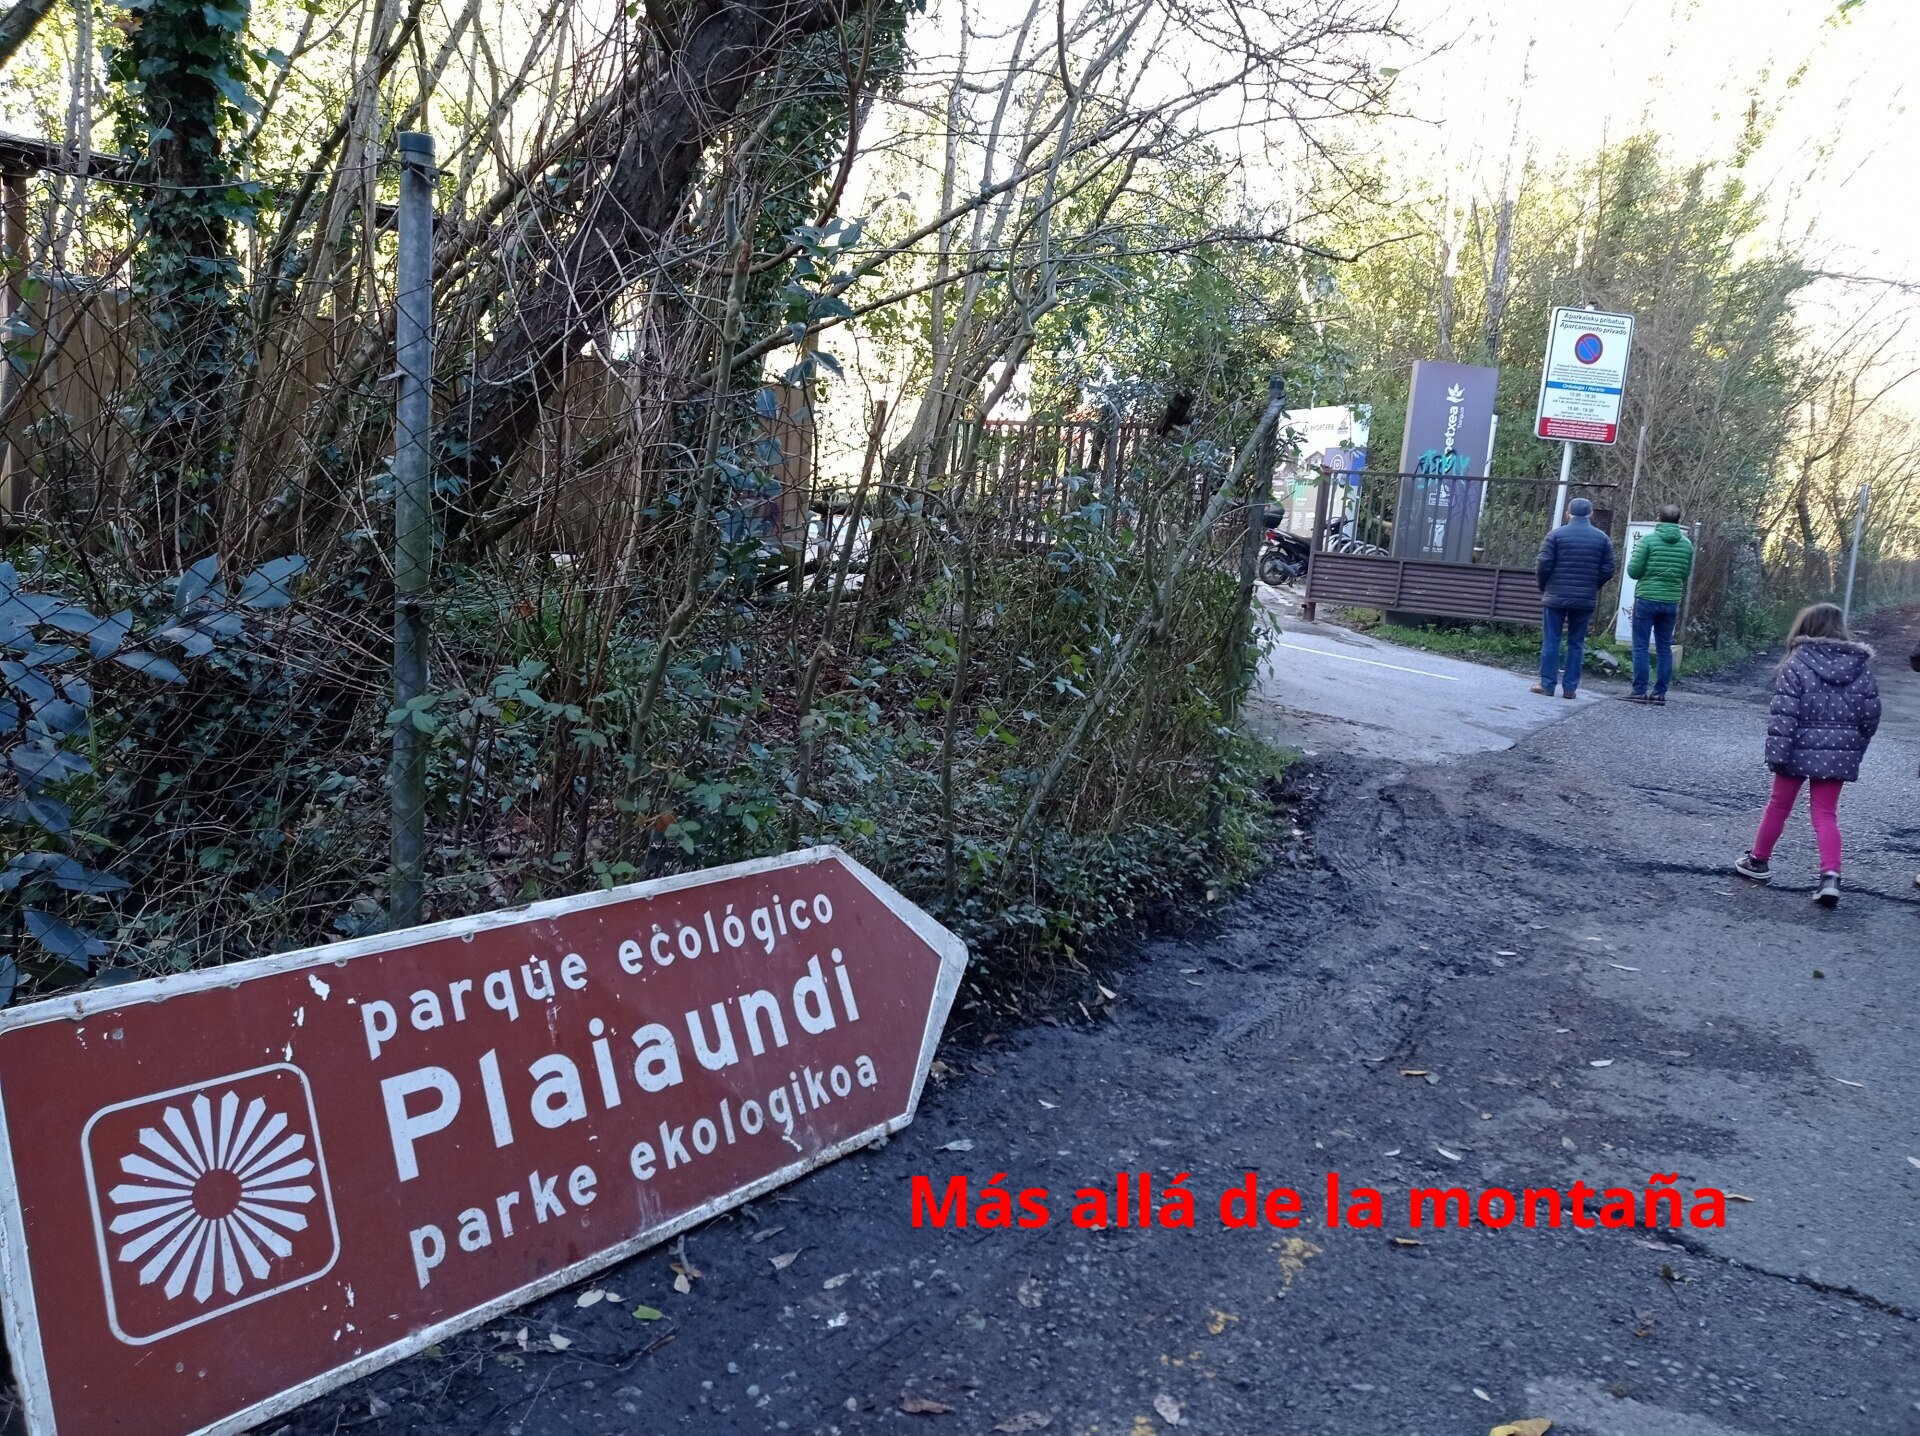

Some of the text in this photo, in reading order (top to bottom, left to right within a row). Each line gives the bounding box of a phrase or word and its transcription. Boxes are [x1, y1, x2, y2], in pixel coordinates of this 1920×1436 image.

[1560, 322, 1627, 336] Aparcamiento privado
[1564, 313, 1625, 325] Aparkaleku pribatua
[361, 892, 833, 1061] parque ecológico
[380, 947, 860, 1183] Plaiaundi
[410, 1054, 878, 1290] parke ekologikoa
